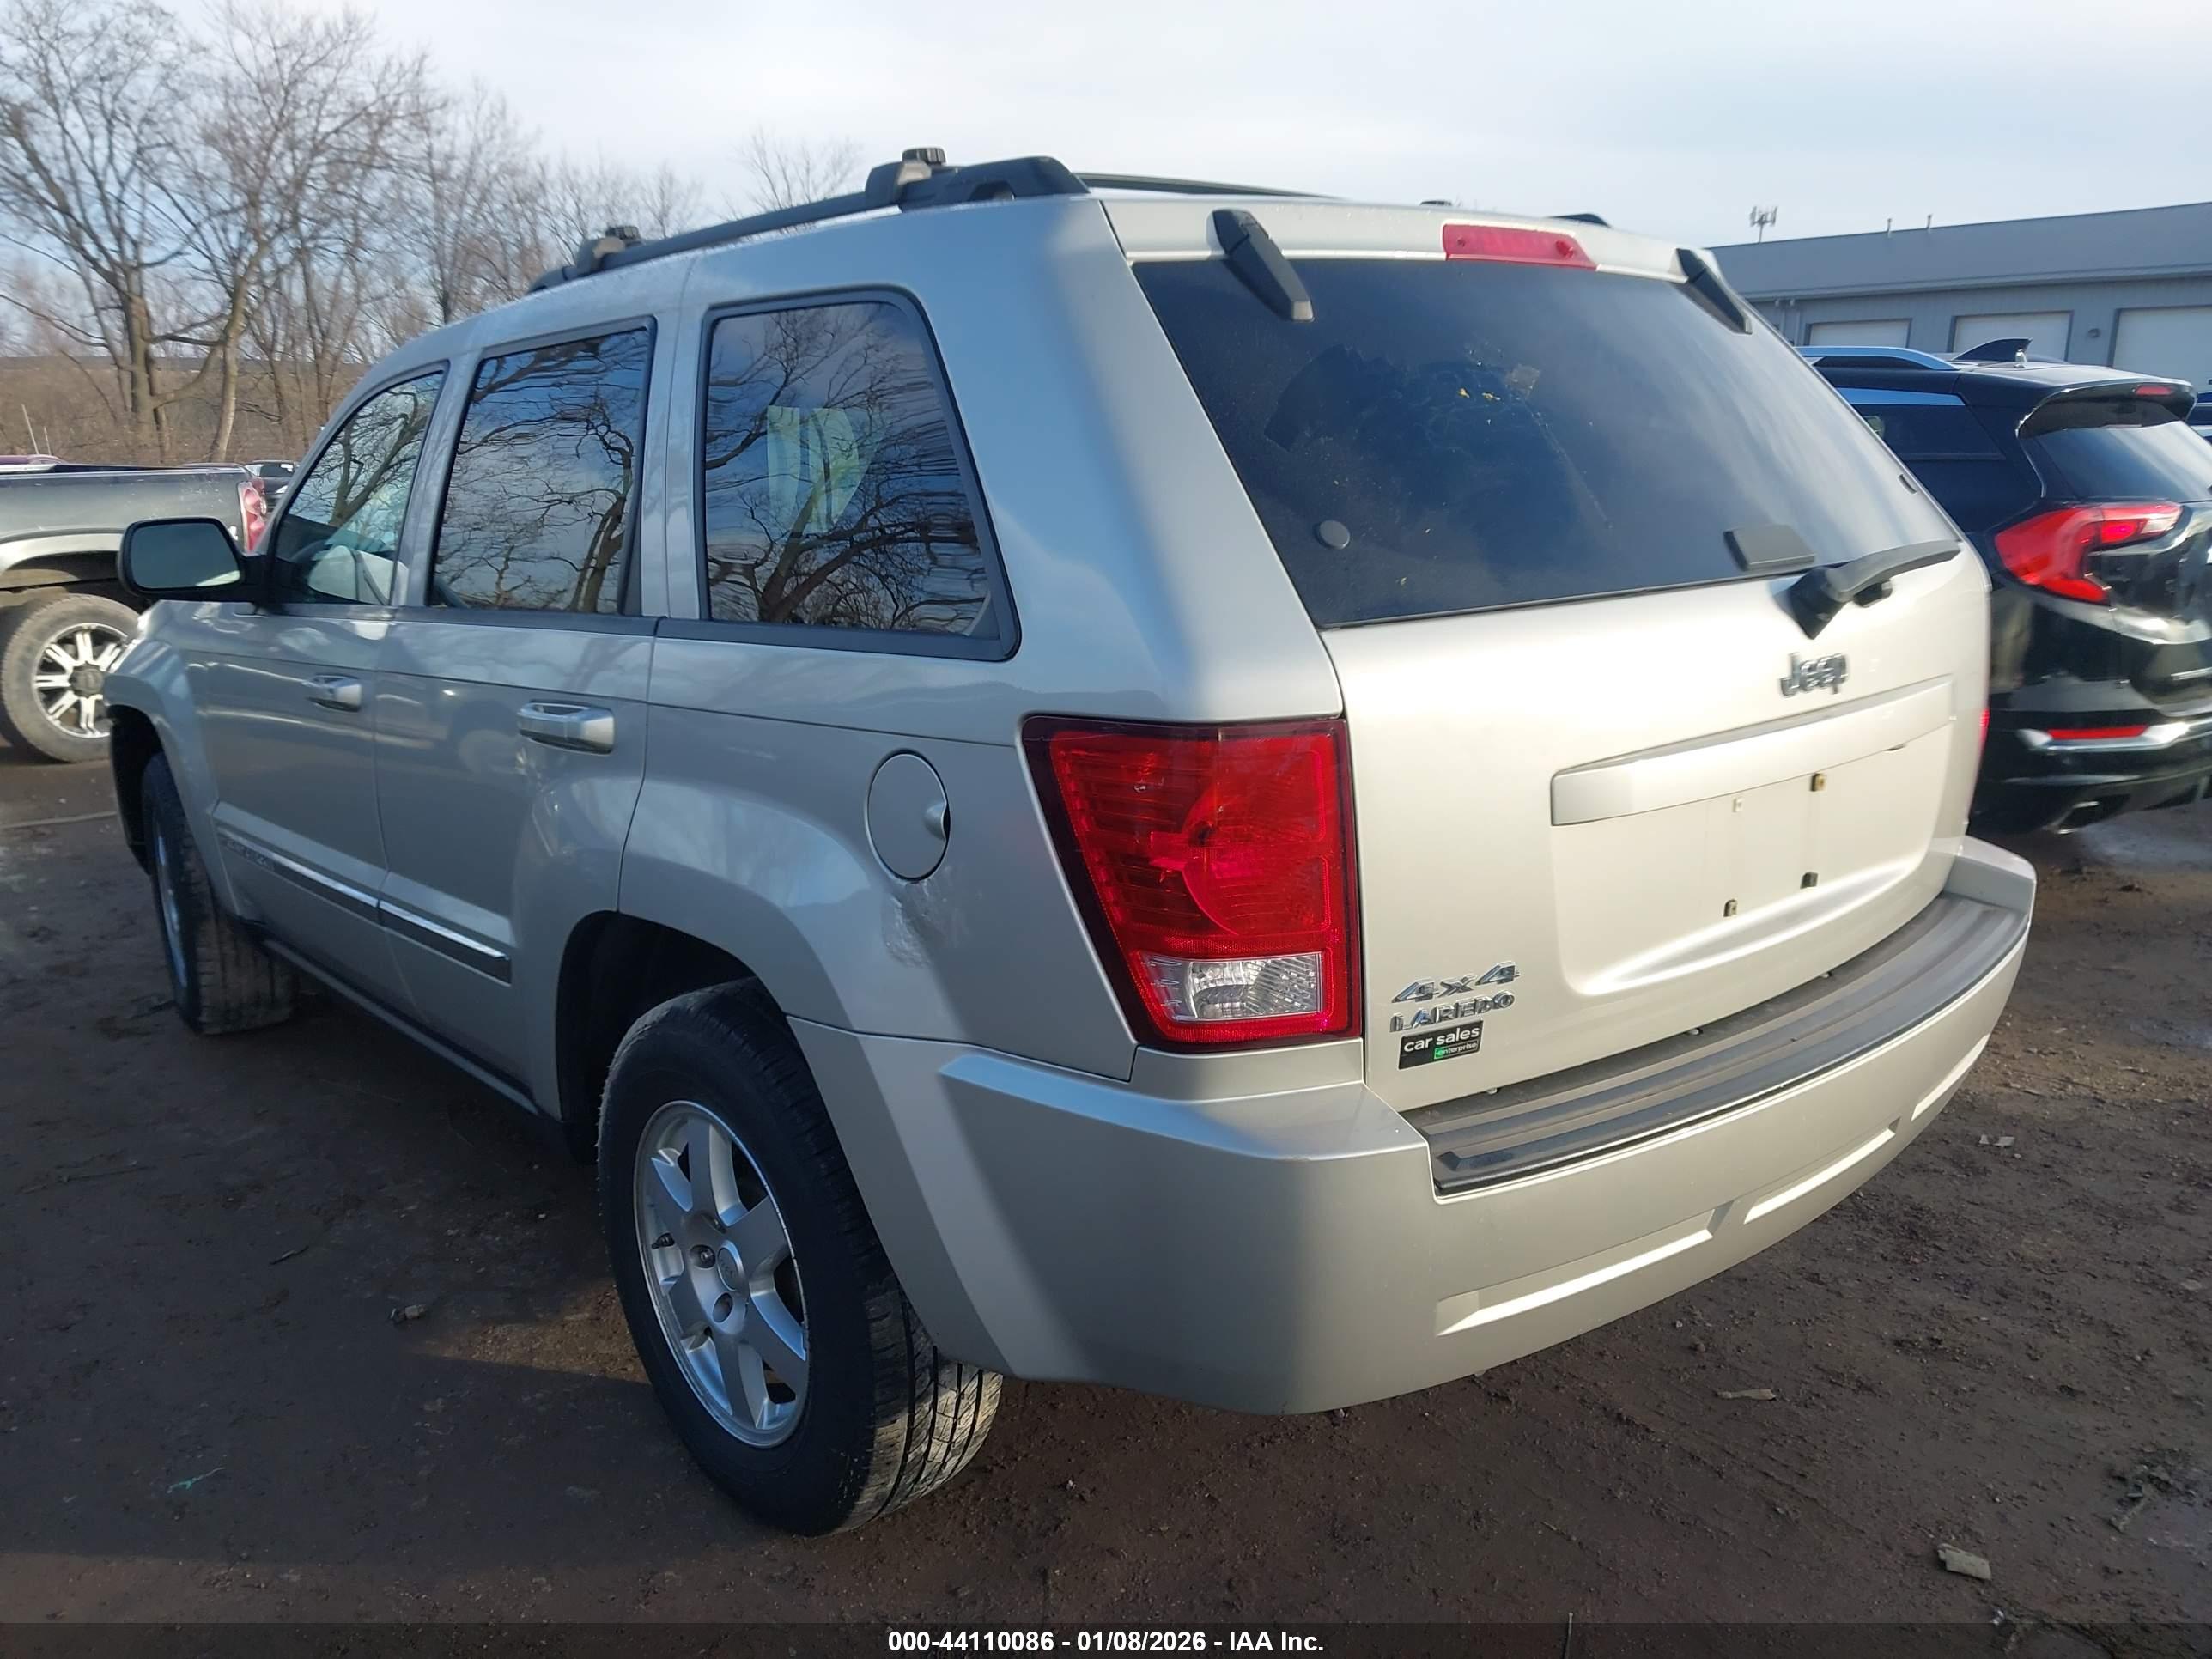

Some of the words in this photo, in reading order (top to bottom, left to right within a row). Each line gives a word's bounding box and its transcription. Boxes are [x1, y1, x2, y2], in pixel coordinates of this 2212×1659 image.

[1778, 653, 1847, 697] Jeep
[1389, 990, 1515, 1032] LAREDO
[1403, 1037, 1432, 1052] car
[1437, 1027, 1480, 1046] sales
[1436, 1042, 1477, 1056] enterprise
